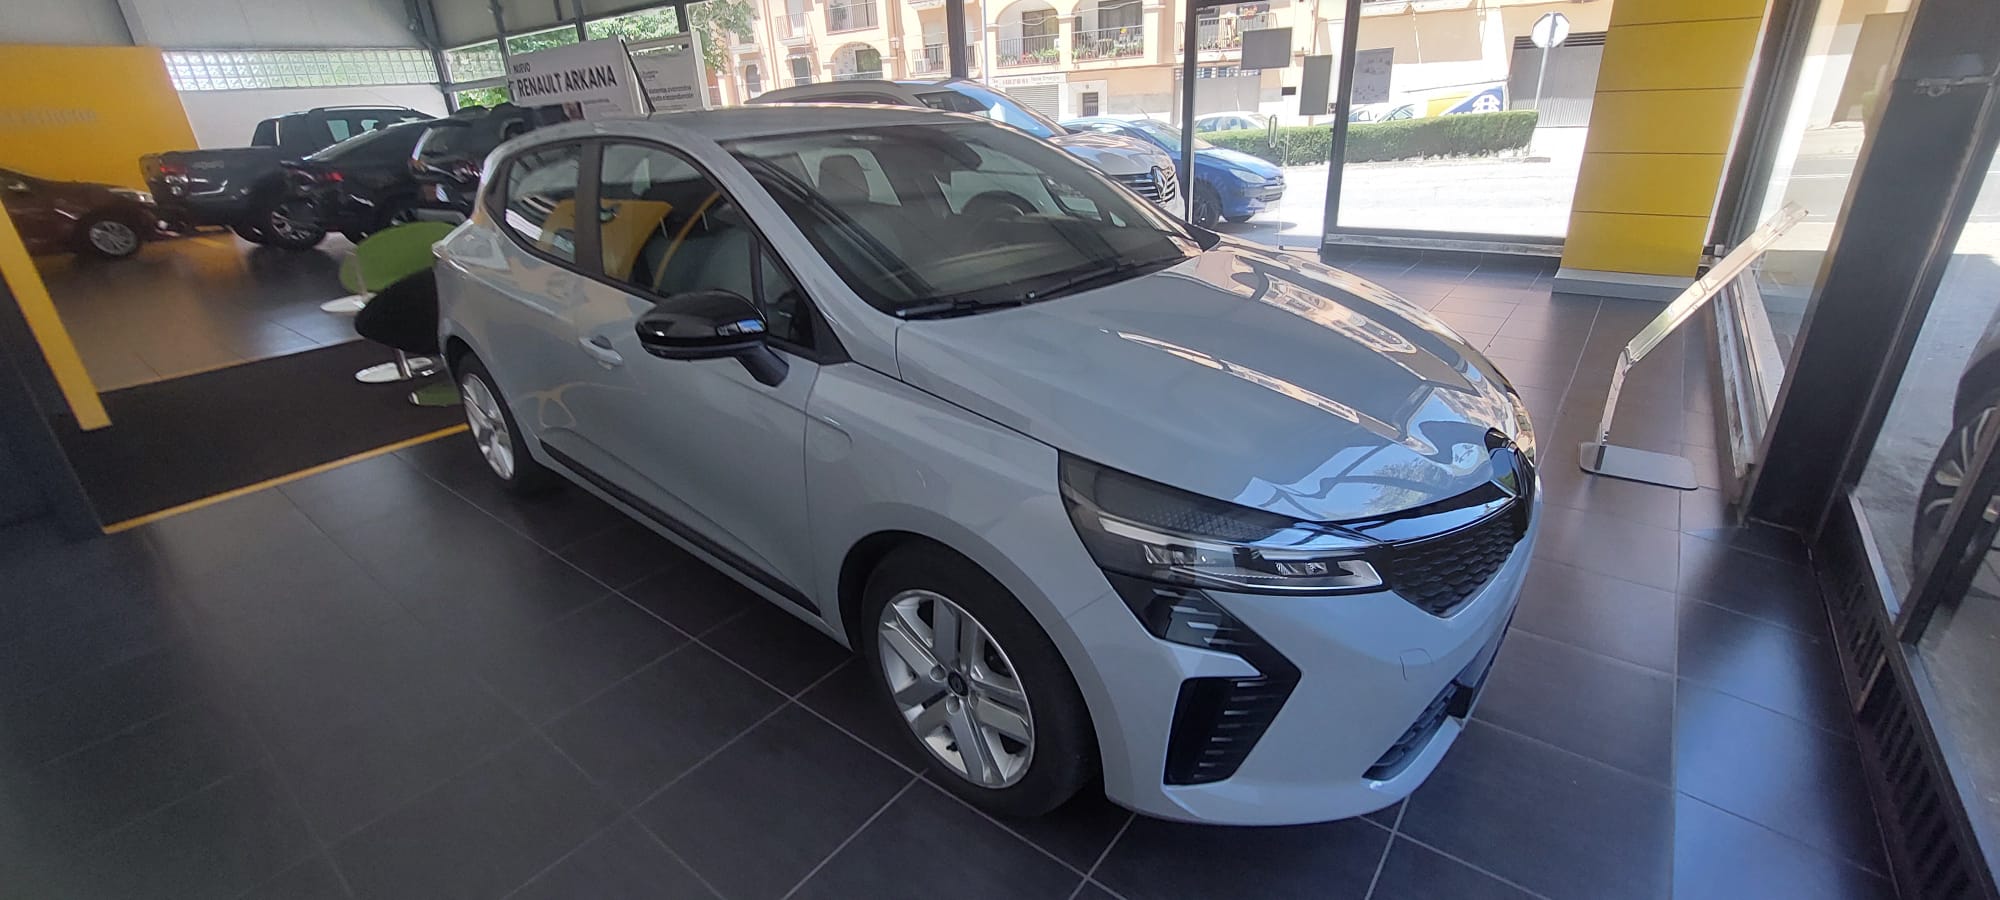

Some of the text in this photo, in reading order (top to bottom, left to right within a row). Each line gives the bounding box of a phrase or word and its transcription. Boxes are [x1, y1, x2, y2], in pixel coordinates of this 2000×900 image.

[513, 62, 531, 74] NUEVO
[517, 65, 617, 97] RENAULT ARKANA
